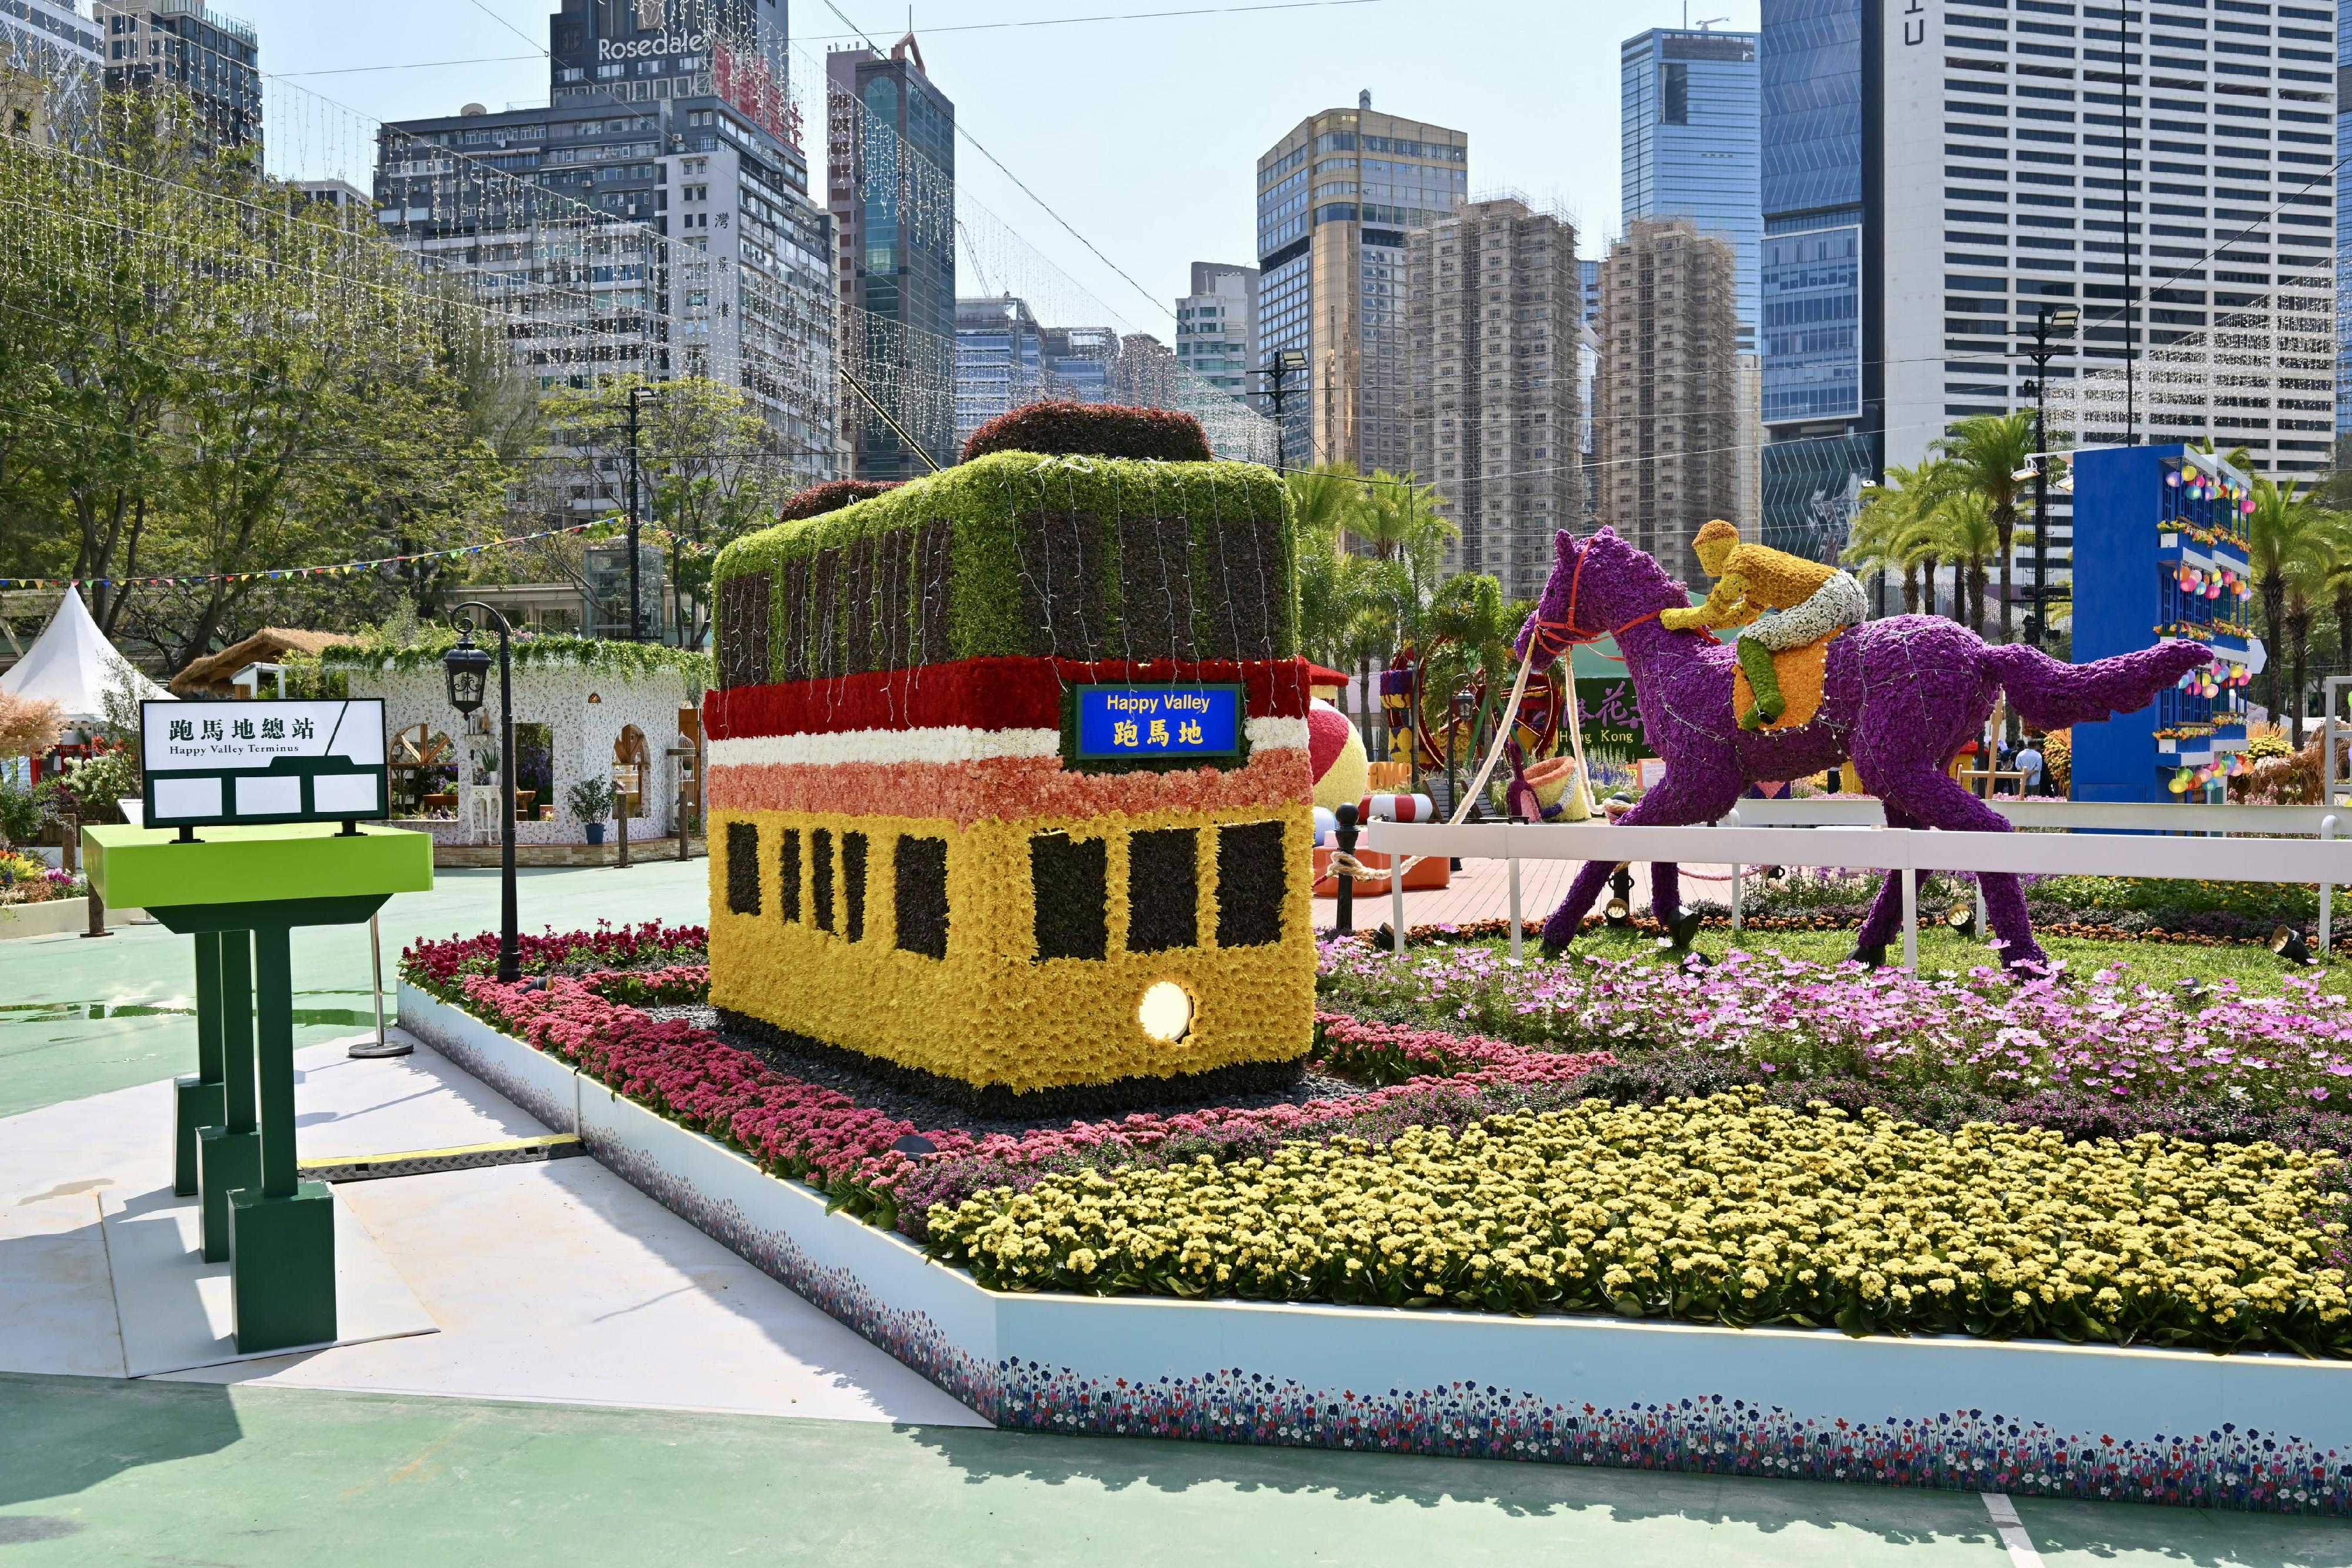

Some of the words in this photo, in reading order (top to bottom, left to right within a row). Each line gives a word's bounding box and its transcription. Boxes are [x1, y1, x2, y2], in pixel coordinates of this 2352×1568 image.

[599, 33, 704, 61] Rosedale
[715, 212, 731, 317] 灣景樓
[1107, 694, 1158, 714] Happy
[1164, 694, 1210, 713] Valley
[169, 717, 315, 741] 跑馬地總站
[1113, 718, 1204, 747] 跑馬地
[1559, 731, 1592, 744] Hng
[1601, 730, 1633, 743] Kong
[169, 745, 206, 757] Happy
[211, 745, 243, 755] Valley
[248, 744, 299, 753] Terminus
